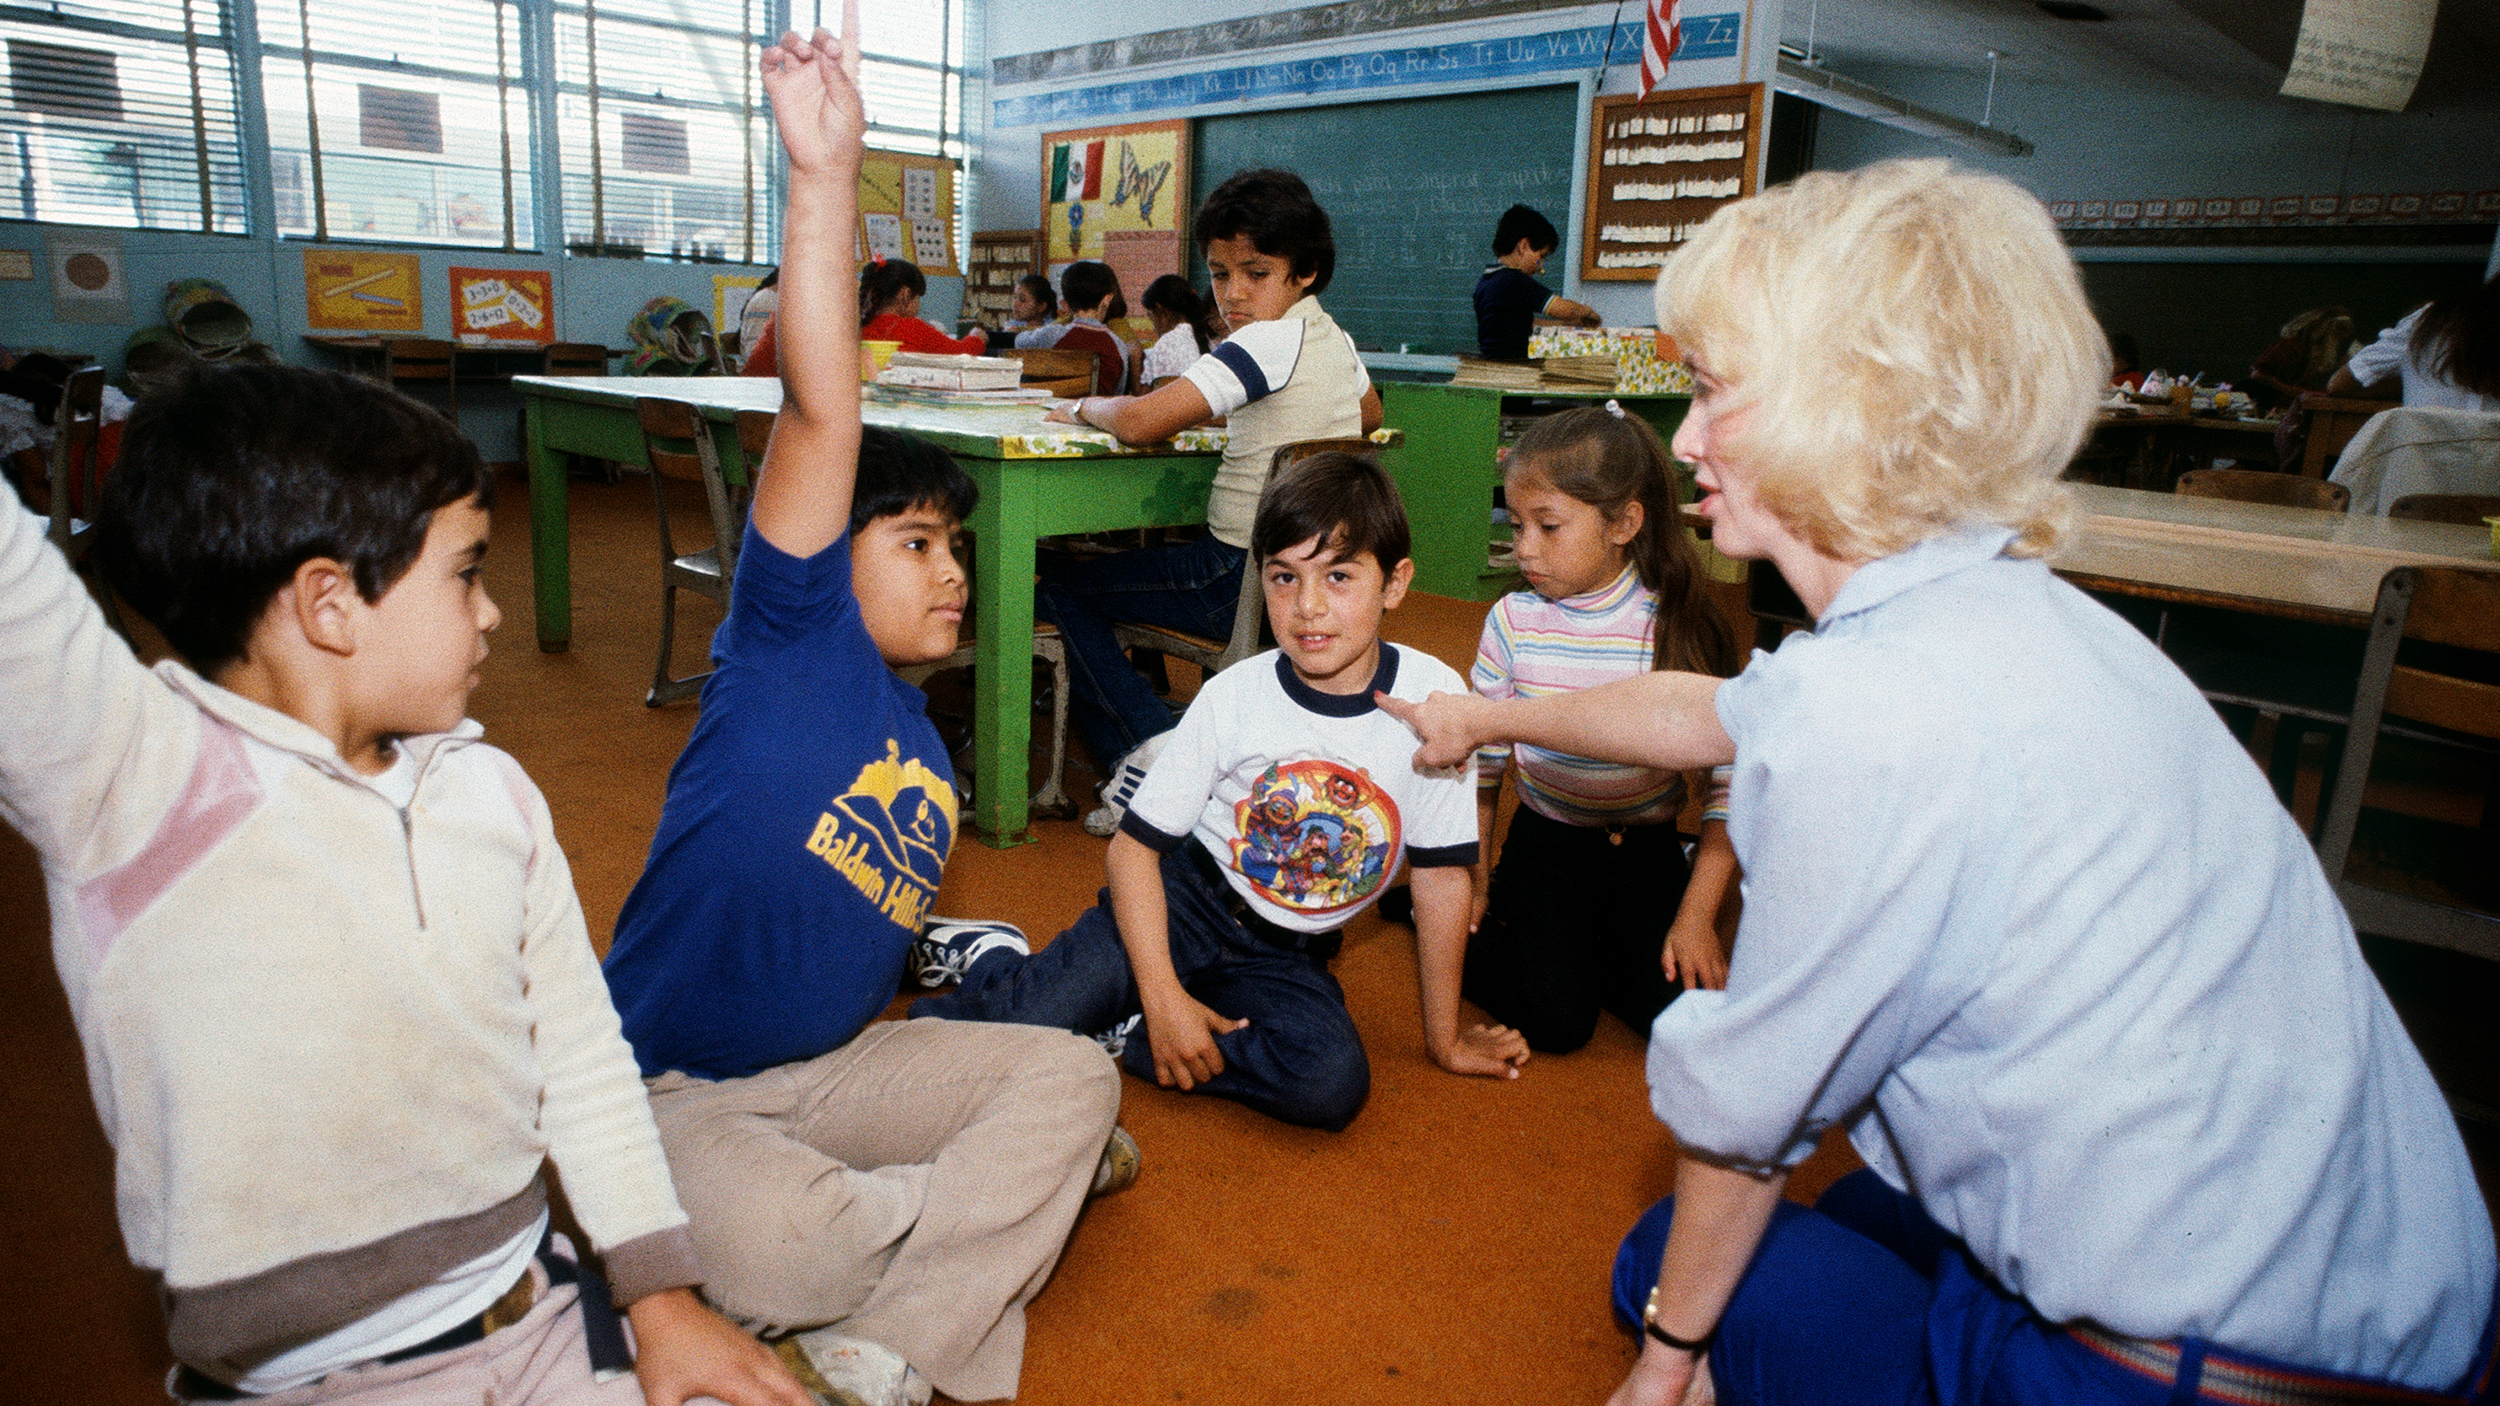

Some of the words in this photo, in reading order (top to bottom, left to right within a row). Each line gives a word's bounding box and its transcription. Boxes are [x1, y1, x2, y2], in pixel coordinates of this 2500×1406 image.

[1311, 60, 1335, 82] Oo
[1341, 56, 1363, 86] Pp
[1370, 53, 1399, 82] Qq
[1406, 50, 1428, 72] Rr
[1438, 47, 1458, 70] Ss
[1472, 42, 1493, 65] Tt
[1507, 39, 1535, 63] Uu
[1547, 33, 1570, 57] Vv
[1705, 18, 1735, 45] Zz
[806, 811, 886, 905] Baldwin
[880, 875, 924, 930] Hills
